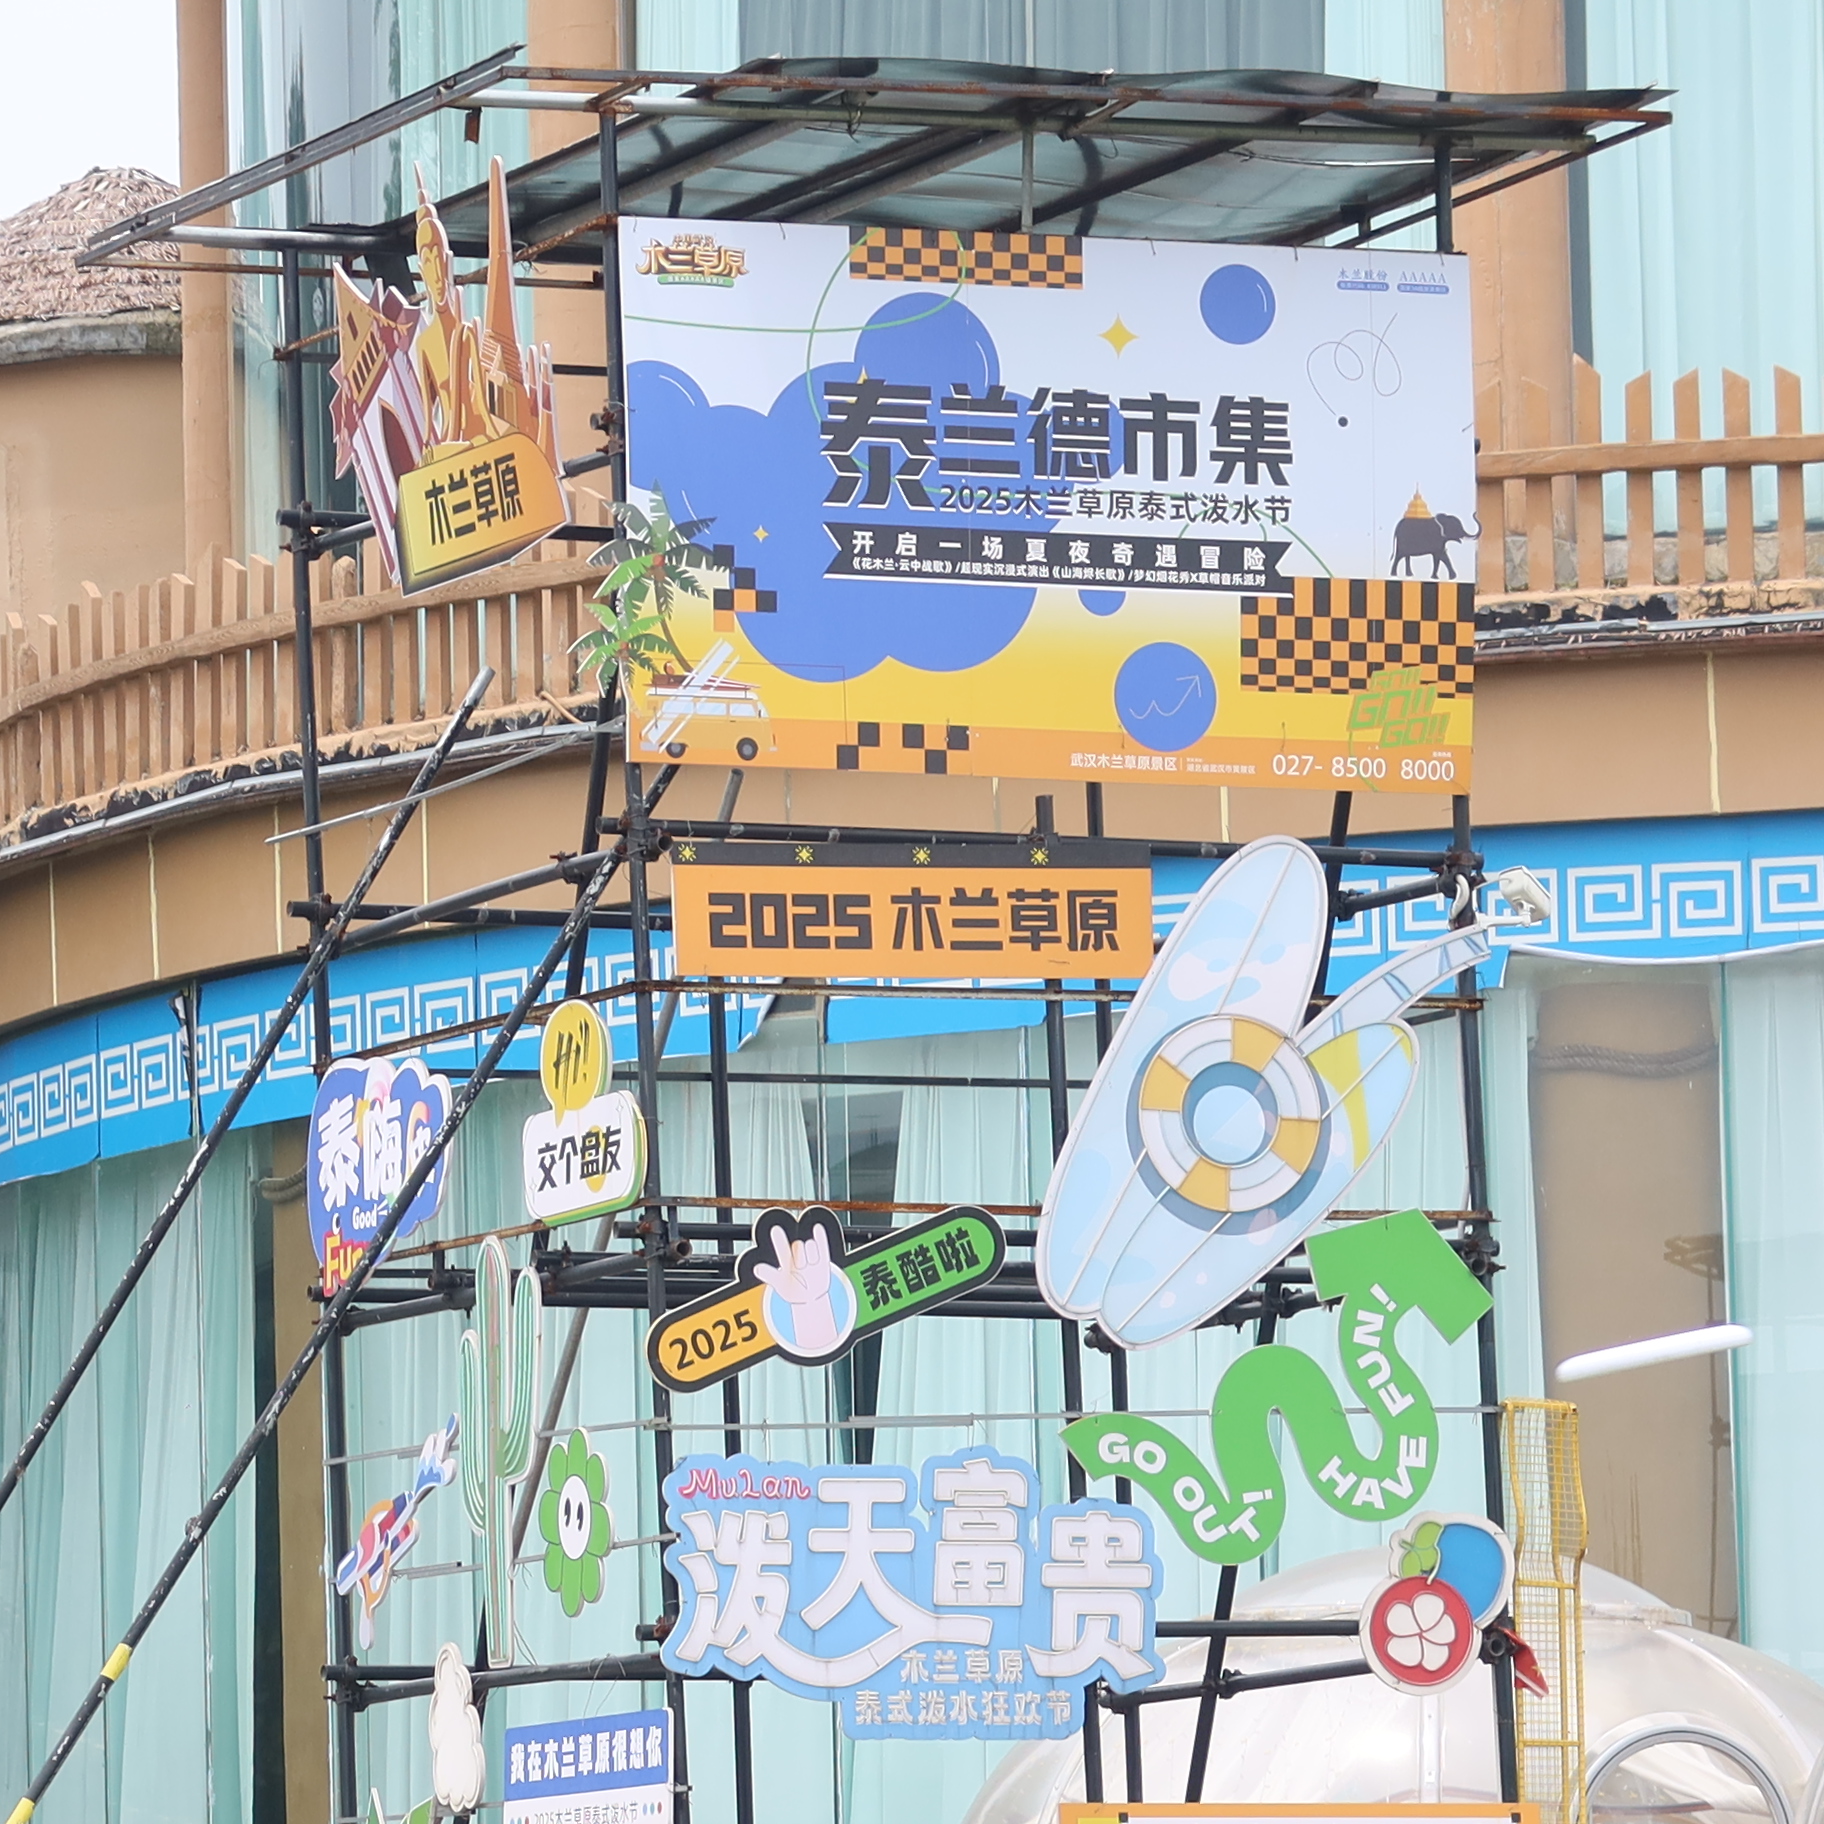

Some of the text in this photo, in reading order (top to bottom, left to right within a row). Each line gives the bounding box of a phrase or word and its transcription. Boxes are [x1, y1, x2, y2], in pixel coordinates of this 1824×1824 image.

[636, 238, 749, 279] 木兰草原
[820, 378, 1294, 511] 泰兰德市集
[424, 452, 524, 546] 木兰草原
[939, 484, 1292, 526] 2025木兰草原泰式泼水节
[852, 530, 1267, 571] 开启一场夏夜奇遇冒险
[1070, 753, 1177, 771] 武汉木兰草原景区
[1331, 756, 1386, 778] 8500
[1401, 759, 1454, 781] 8000
[707, 887, 1119, 952] 2025 木兰草原
[537, 1125, 621, 1193] 交个盘友
[352, 1204, 378, 1230] Good
[860, 1226, 981, 1311] 泰酷啦
[669, 1309, 758, 1371] 2025
[1317, 1283, 1427, 1510] HAVE FUN!
[1098, 1432, 1167, 1474] GO
[675, 1458, 1155, 1688] 泼天富贵
[900, 1649, 1025, 1685] 木兰草原
[855, 1689, 1072, 1726] 泰式泼水狂欢节
[510, 1726, 662, 1784] 我在木兰草原很想你
